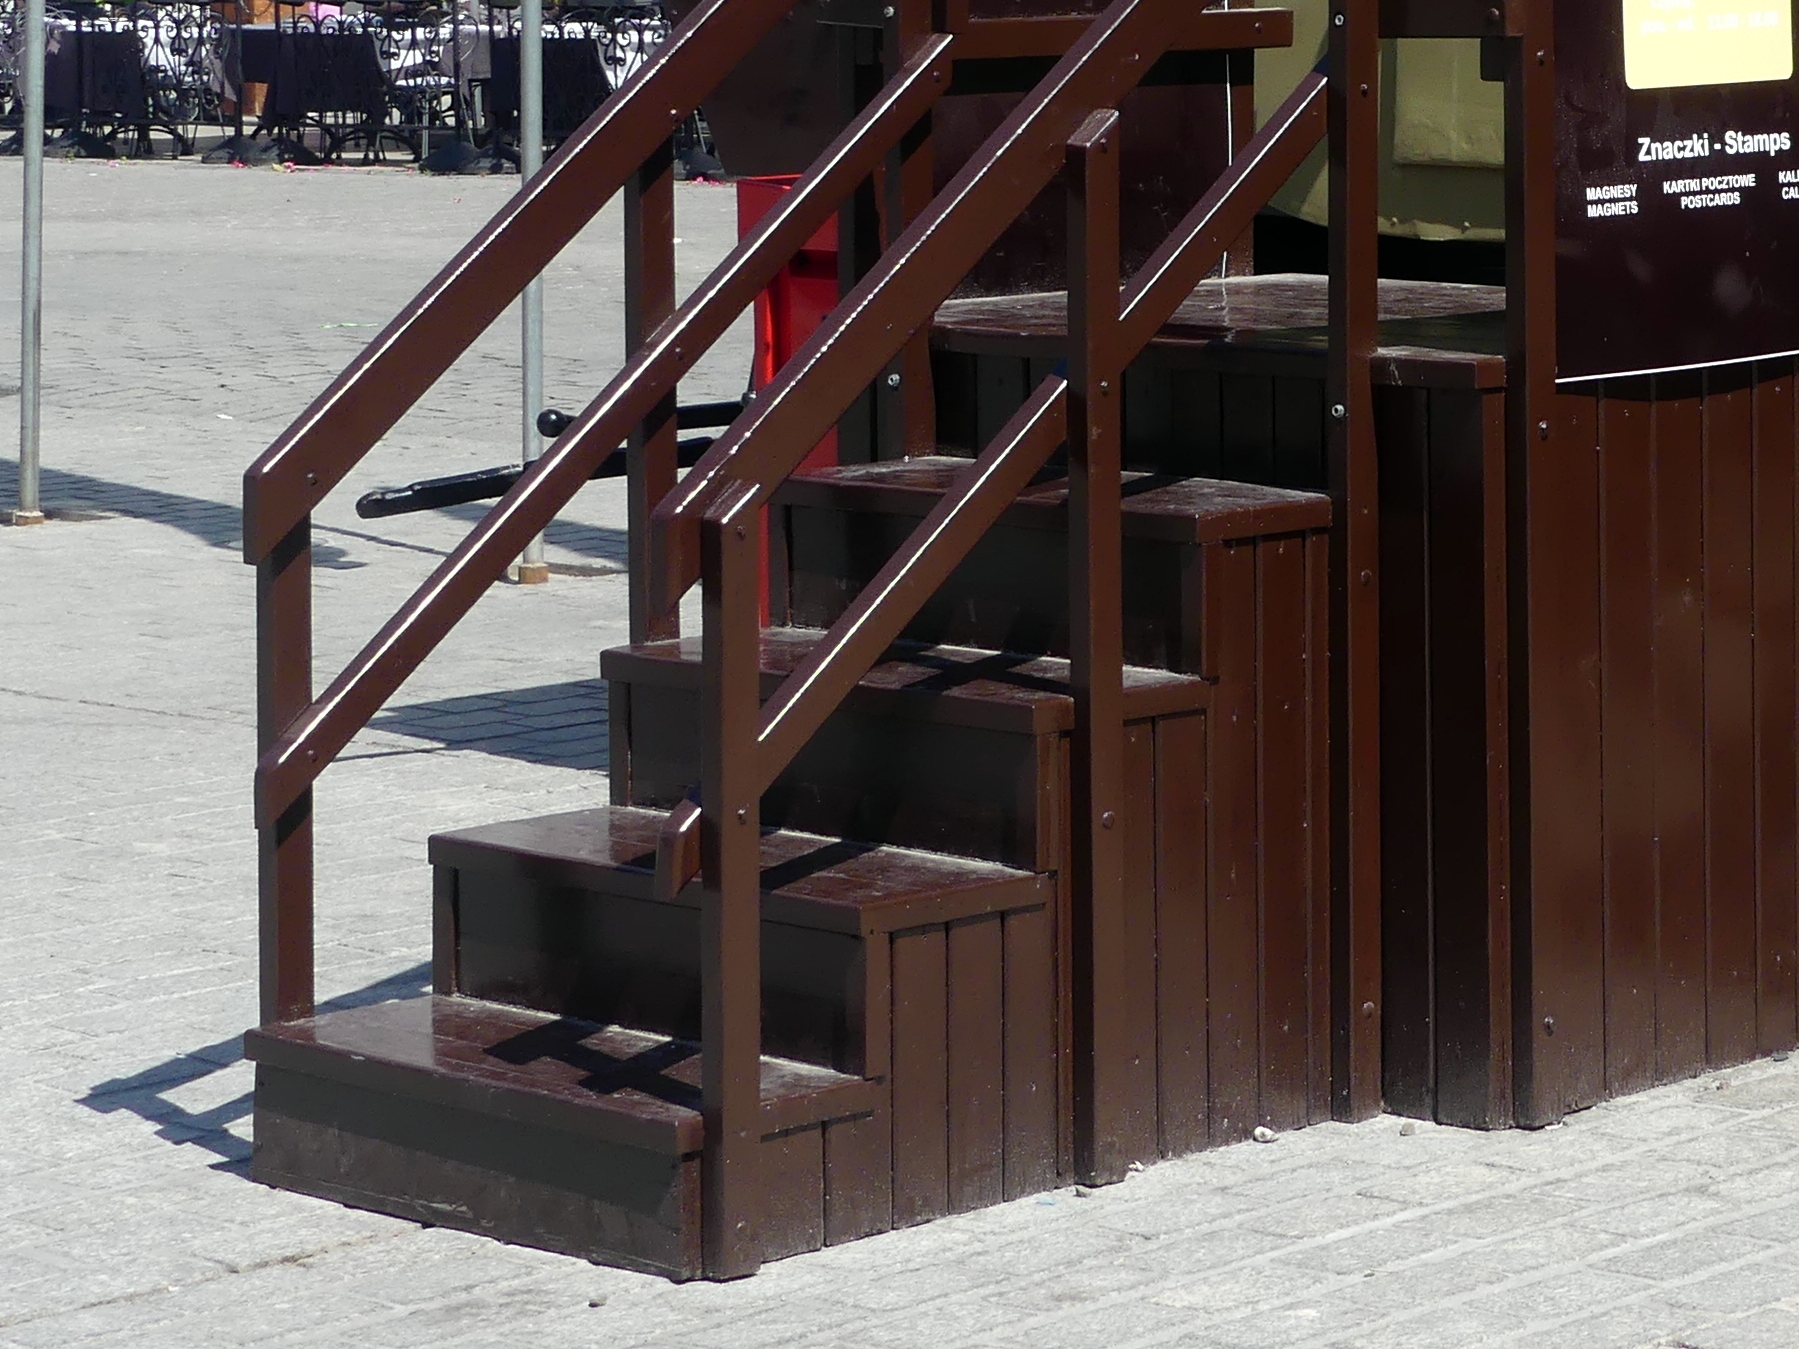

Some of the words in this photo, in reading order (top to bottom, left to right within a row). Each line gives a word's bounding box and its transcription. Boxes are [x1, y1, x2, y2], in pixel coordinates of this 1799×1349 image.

[1637, 133, 1709, 162] Znaczki
[1724, 130, 1791, 156] Stamps
[1586, 184, 1638, 200] MAGNESY
[1663, 177, 1700, 194] KARTKI
[1701, 173, 1756, 191] POCZTOWE
[1681, 191, 1741, 209] POSTCARDS
[1587, 201, 1639, 218] MAGNETS
